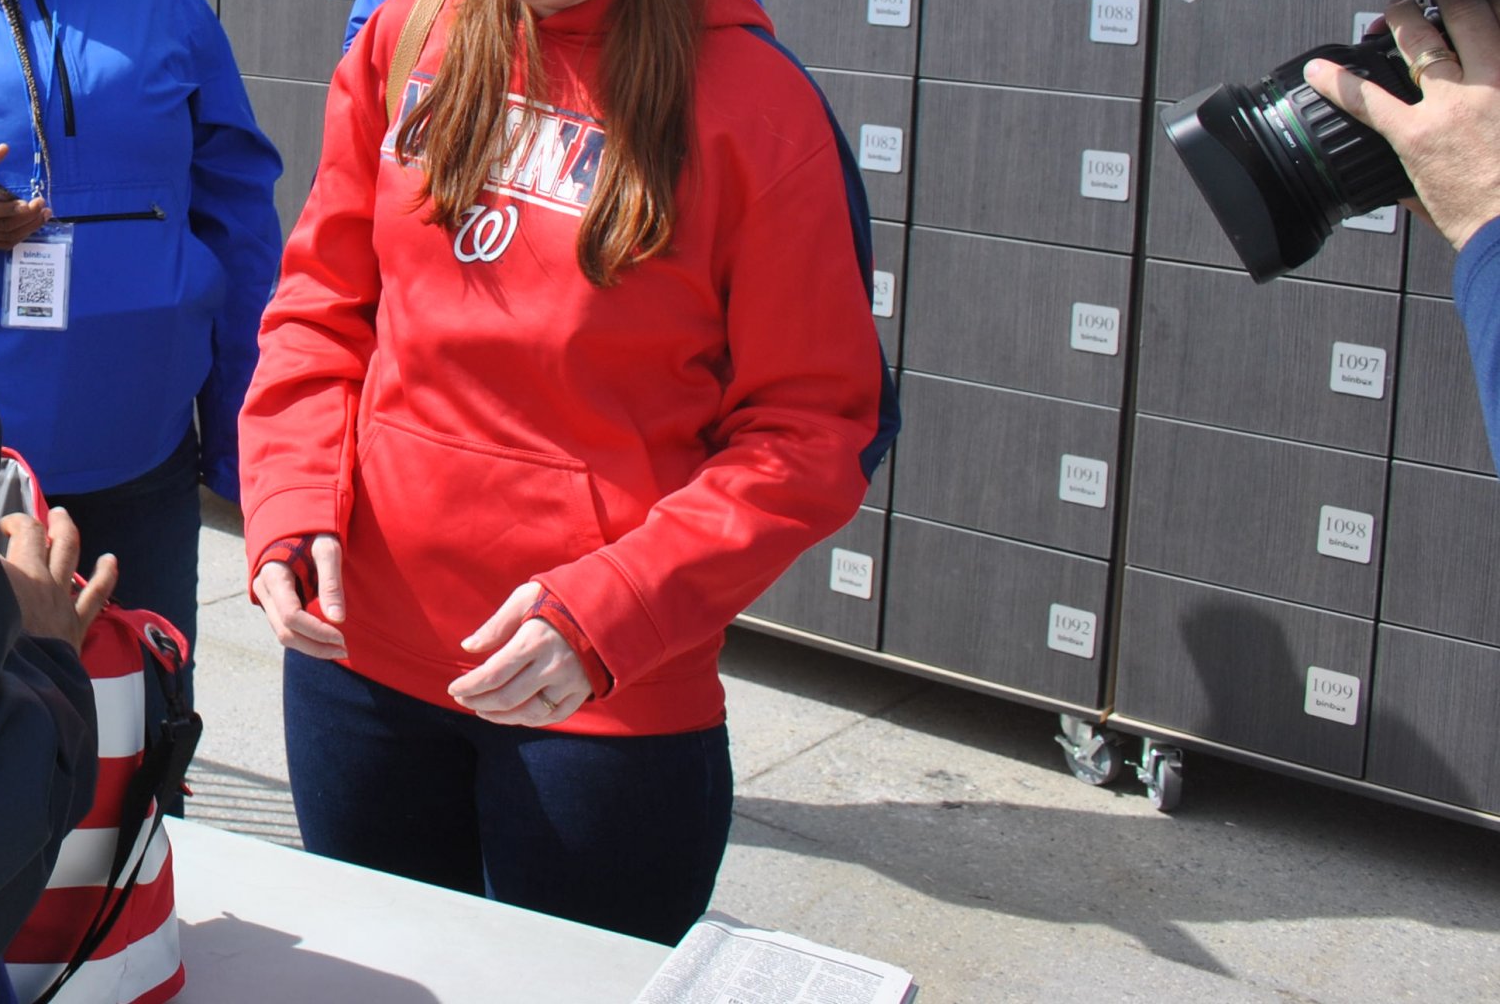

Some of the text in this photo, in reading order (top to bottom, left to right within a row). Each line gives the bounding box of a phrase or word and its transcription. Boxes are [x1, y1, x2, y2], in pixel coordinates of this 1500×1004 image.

[1097, 4, 1134, 20] 1088
[865, 134, 897, 150] 1082
[1088, 160, 1124, 176] 1089
[454, 204, 518, 263] W
[1078, 313, 1114, 331] 1090
[1339, 353, 1379, 373] 1097
[1067, 465, 1100, 484] 1091
[1326, 516, 1366, 539] 1098
[836, 558, 867, 576] 1085
[1055, 614, 1090, 635] 1092
[1314, 678, 1353, 699] 1099
